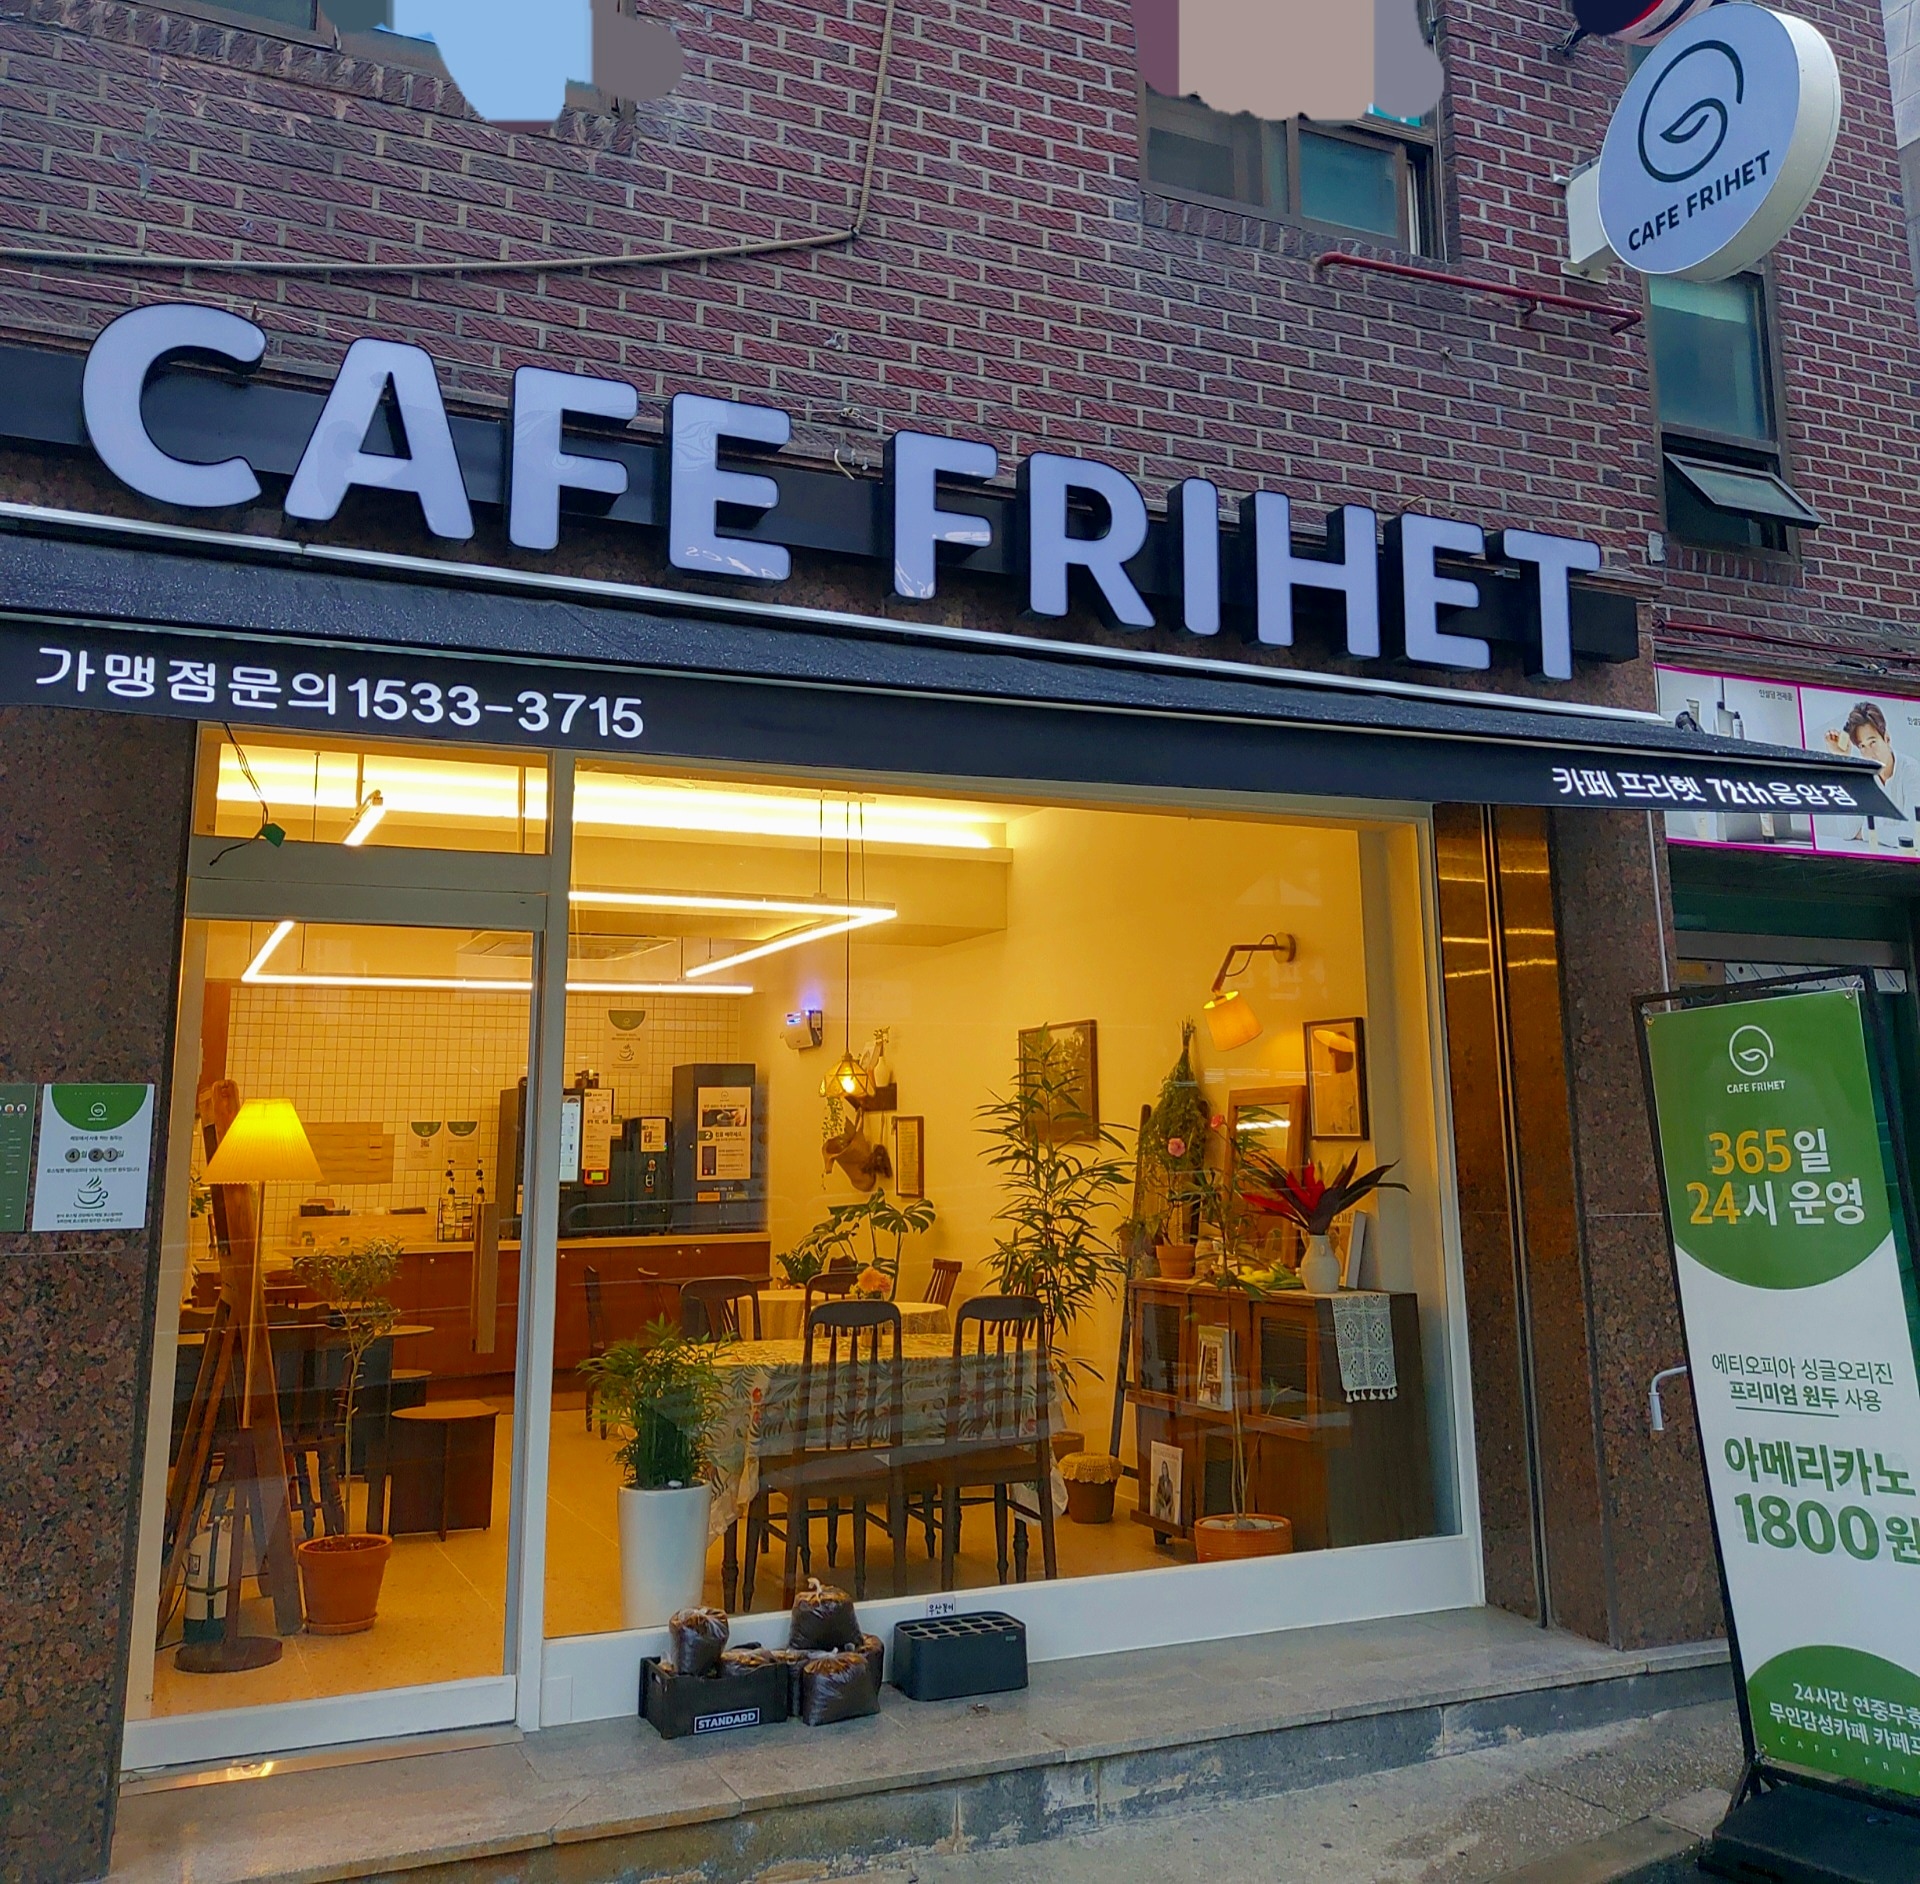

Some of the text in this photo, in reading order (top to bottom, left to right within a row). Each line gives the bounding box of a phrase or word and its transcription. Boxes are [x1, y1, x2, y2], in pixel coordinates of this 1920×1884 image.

[1628, 150, 1771, 251] CAFE FRIHET
[82, 303, 1602, 681] CAFE FRIHET
[1552, 766, 1859, 807] 카페 프리헷 72th응암점
[1726, 1079, 1786, 1094] CAFE FRIHET
[1707, 1127, 1832, 1176] 365일
[1685, 1177, 1866, 1226] 24시 운영
[1711, 1352, 1894, 1386] 에티오피아 싱글오리진
[1729, 1381, 1882, 1413] 프리미엄 원두 사용
[1723, 1436, 1917, 1496] 아메리카노
[1734, 1492, 1920, 1566] 1800원
[1792, 1682, 1849, 1714] 24시간
[697, 1711, 757, 1731] STANDARD
[1769, 1701, 1870, 1746] 무인감성카페
